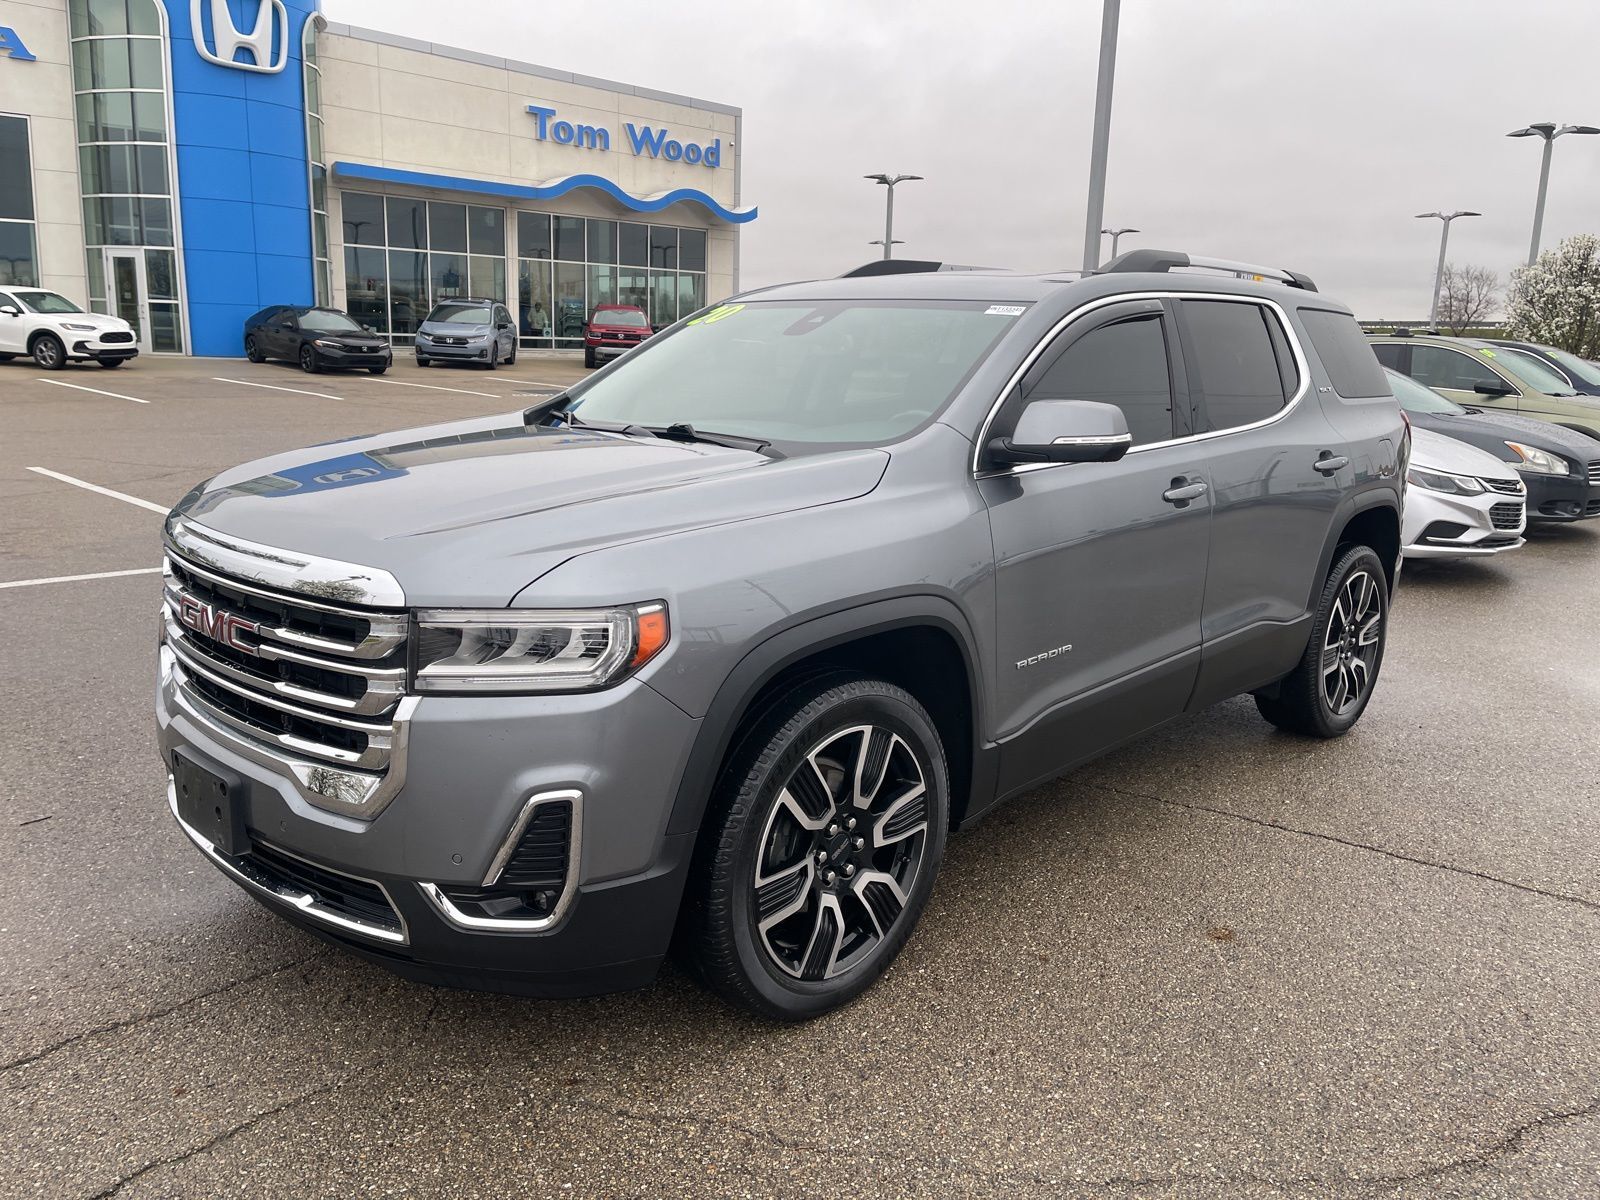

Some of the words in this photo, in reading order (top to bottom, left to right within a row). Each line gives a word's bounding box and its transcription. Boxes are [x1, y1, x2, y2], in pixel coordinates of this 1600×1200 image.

[526, 105, 610, 151] Tom
[624, 122, 721, 168] Wood
[179, 592, 260, 658] GMC
[1015, 644, 1073, 670] ACADIA
